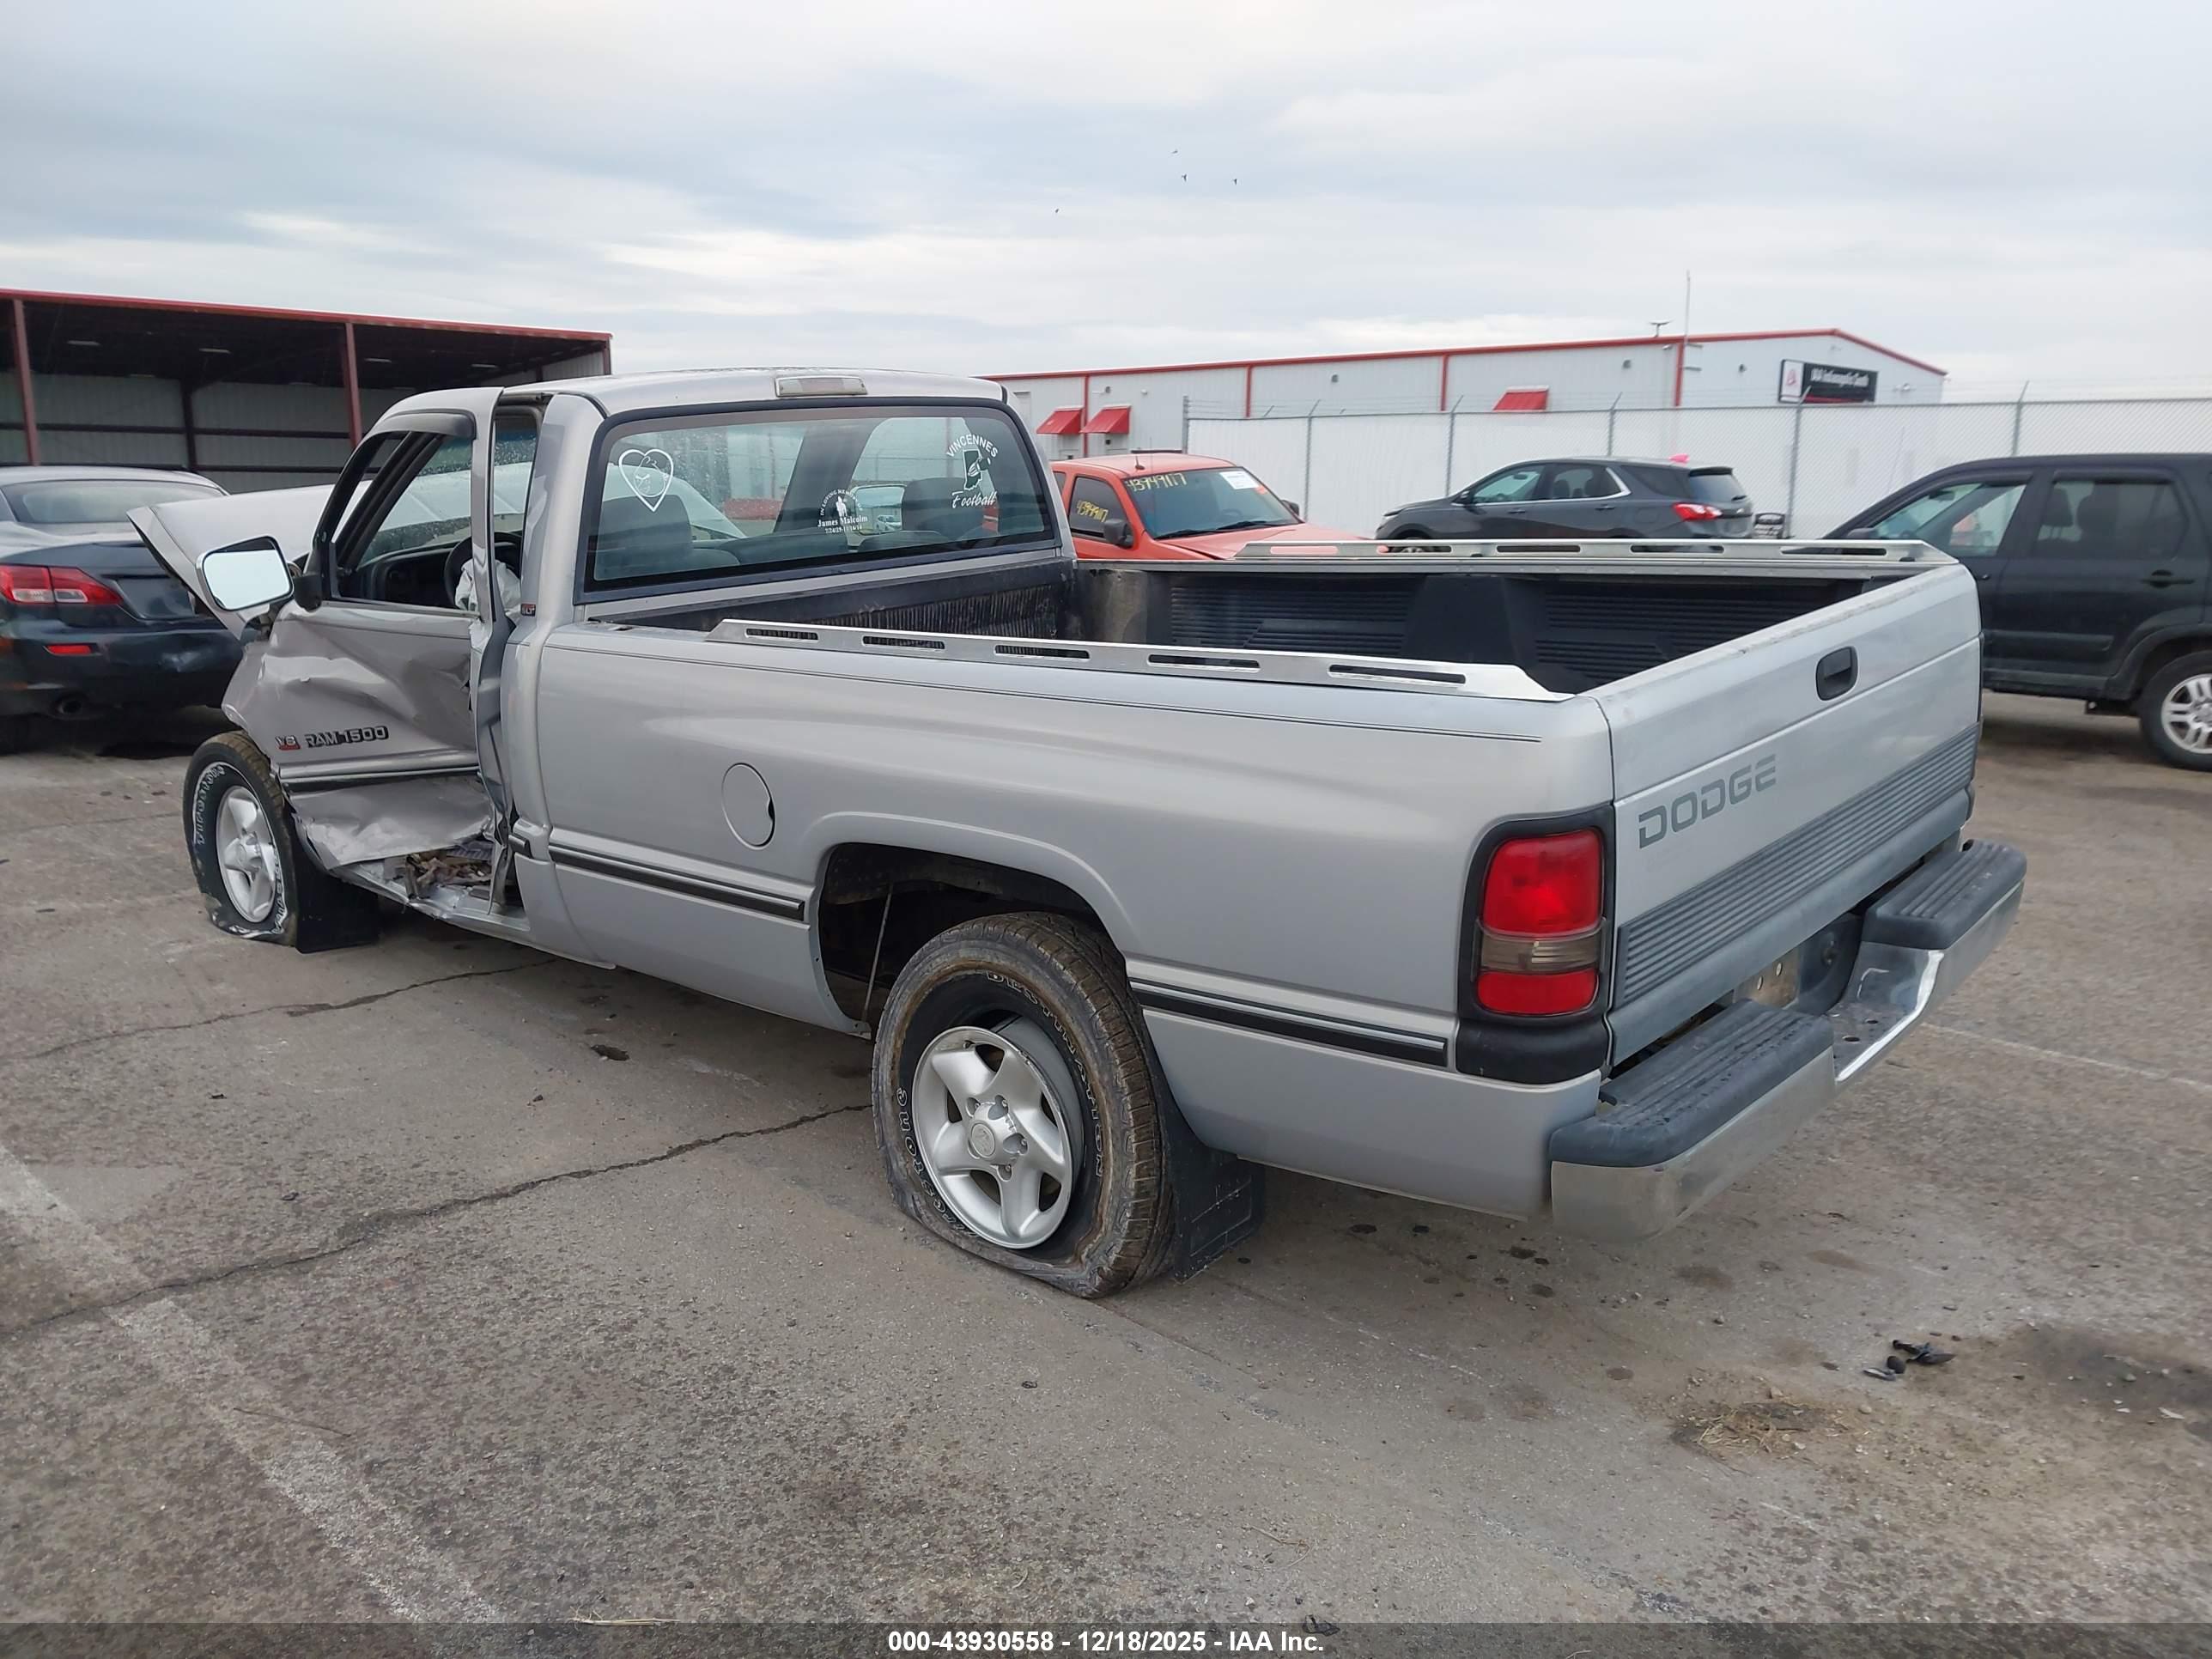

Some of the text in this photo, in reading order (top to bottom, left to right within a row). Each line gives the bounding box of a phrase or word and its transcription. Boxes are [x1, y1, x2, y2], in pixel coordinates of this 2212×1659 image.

[946, 434, 998, 457] VINCENNES
[951, 491, 997, 508] Football
[840, 515, 868, 525] Malcolm
[305, 726, 389, 748] RAM 1500
[1638, 754, 1776, 848] DODGE
[986, 970, 1106, 1177] DESTINATION
